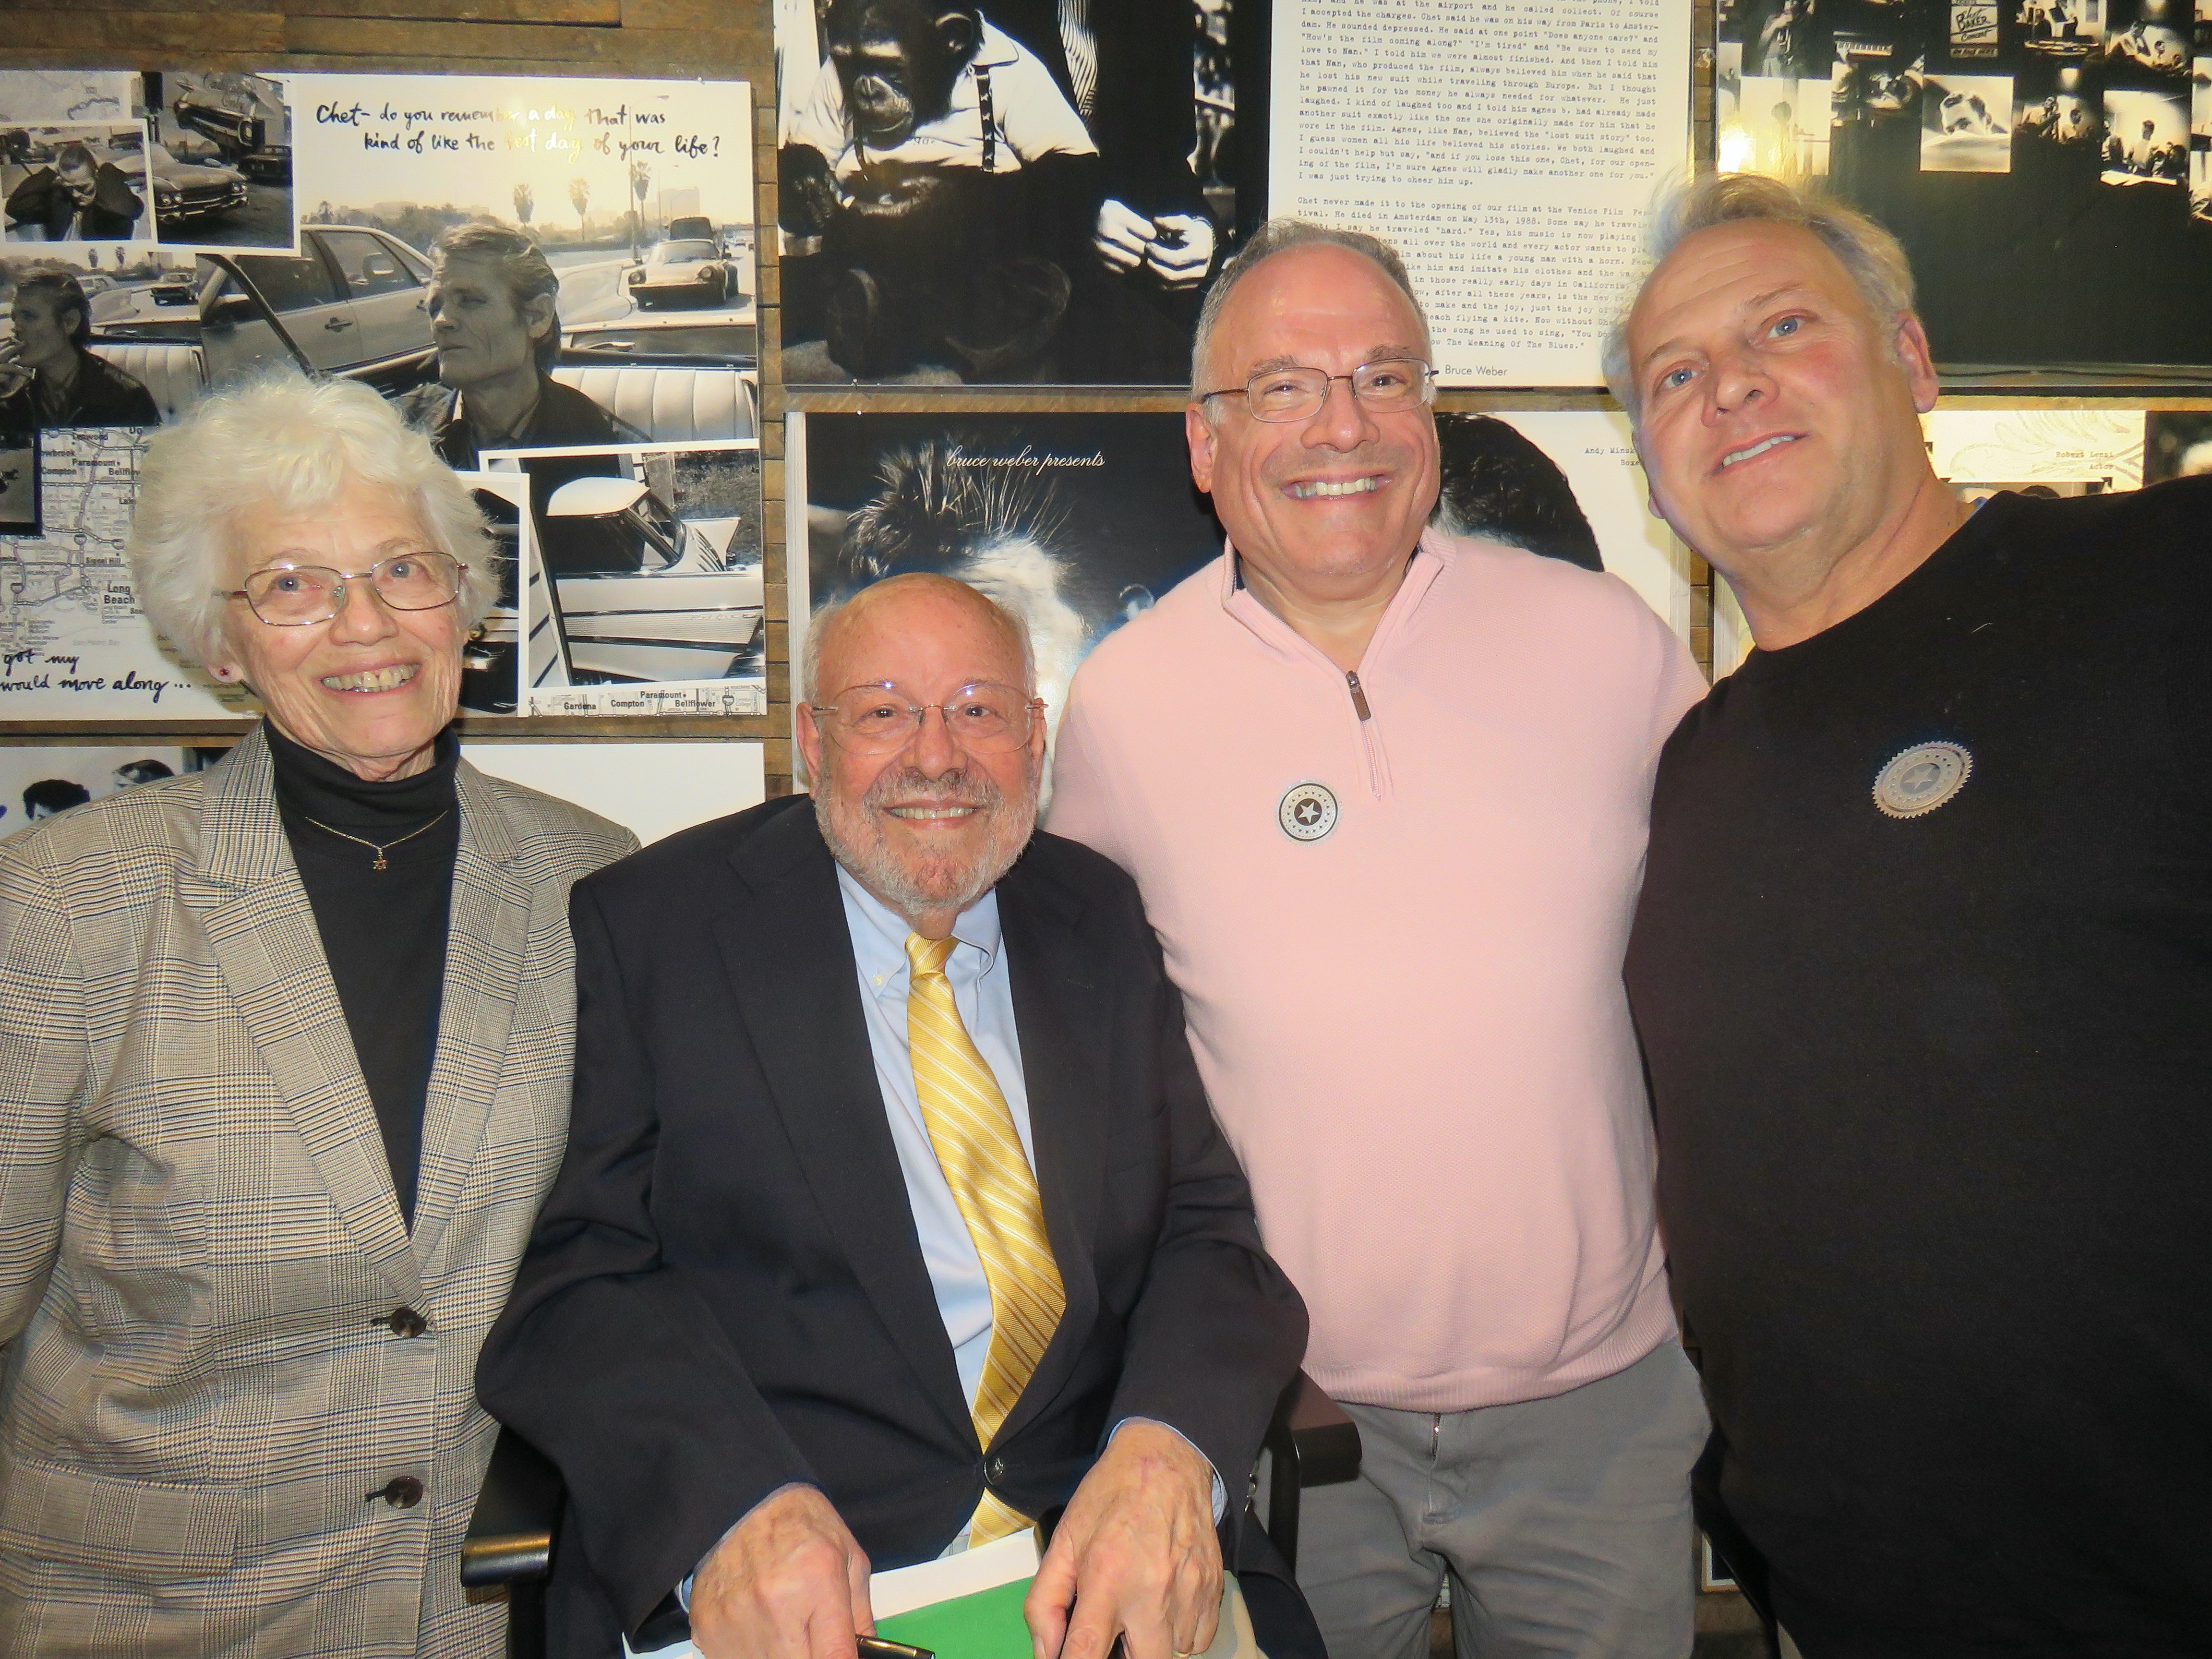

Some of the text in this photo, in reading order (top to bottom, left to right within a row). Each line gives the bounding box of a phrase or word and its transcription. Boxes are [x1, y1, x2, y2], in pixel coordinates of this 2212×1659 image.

[1310, 9, 1352, 18] accepted
[1357, 10, 1371, 18] the
[1421, 12, 1441, 21] Chet
[1446, 14, 1466, 23] said
[1517, 17, 1532, 25] his
[1537, 19, 1551, 27] way
[1556, 19, 1576, 27] from
[1580, 20, 1605, 28] Paris
[1610, 21, 1619, 29] to
[1326, 21, 1336, 29] He
[1341, 23, 1378, 31] sounded
[1513, 30, 1538, 38] point
[1573, 33, 1603, 42] anyone
[380, 102, 397, 121] do
[404, 110, 433, 130] you
[528, 108, 541, 121] a
[544, 104, 576, 132] day
[635, 112, 666, 124] was
[364, 132, 400, 150] kind
[407, 130, 425, 154] of
[432, 133, 459, 150] like
[465, 134, 496, 151] the
[545, 132, 583, 164] day
[593, 132, 611, 156] of
[619, 139, 666, 161] your
[674, 135, 720, 158] life?
[1354, 148, 1375, 158] help
[1451, 152, 1460, 160] if
[1510, 155, 1530, 163] this
[1330, 173, 1349, 182] just
[1356, 174, 1386, 184] trying
[1392, 175, 1402, 183] to
[1407, 176, 1433, 184] cheer
[1438, 177, 1454, 185] him
[1298, 196, 1318, 204] Chet
[1354, 199, 1374, 207] made
[1410, 201, 1425, 209] the
[1431, 202, 1467, 212] opening
[1547, 205, 1562, 214] the
[1567, 206, 1598, 215] Venice
[1603, 207, 1623, 216] Film
[1351, 211, 1372, 219] died
[1378, 212, 1388, 220] in
[1393, 213, 1441, 222] Amsterdam
[1547, 218, 1568, 226] Some
[1416, 251, 1443, 259] about
[1449, 252, 1465, 260] his
[1471, 252, 1491, 261] life
[1508, 255, 1535, 264] young
[1446, 337, 1462, 346] The
[1527, 340, 1542, 349] The
[1445, 364, 1508, 376] Bruce Weber
[946, 445, 1106, 476] bruce weber presents
[107, 583, 131, 594] Long
[103, 595, 136, 604] Beach
[3, 649, 80, 676] got my
[0, 674, 50, 692] would
[58, 677, 107, 692] move
[640, 690, 682, 699] Paramount
[563, 702, 597, 710] Gardena
[610, 699, 645, 708] Compton
[674, 699, 716, 708] Bellflower
